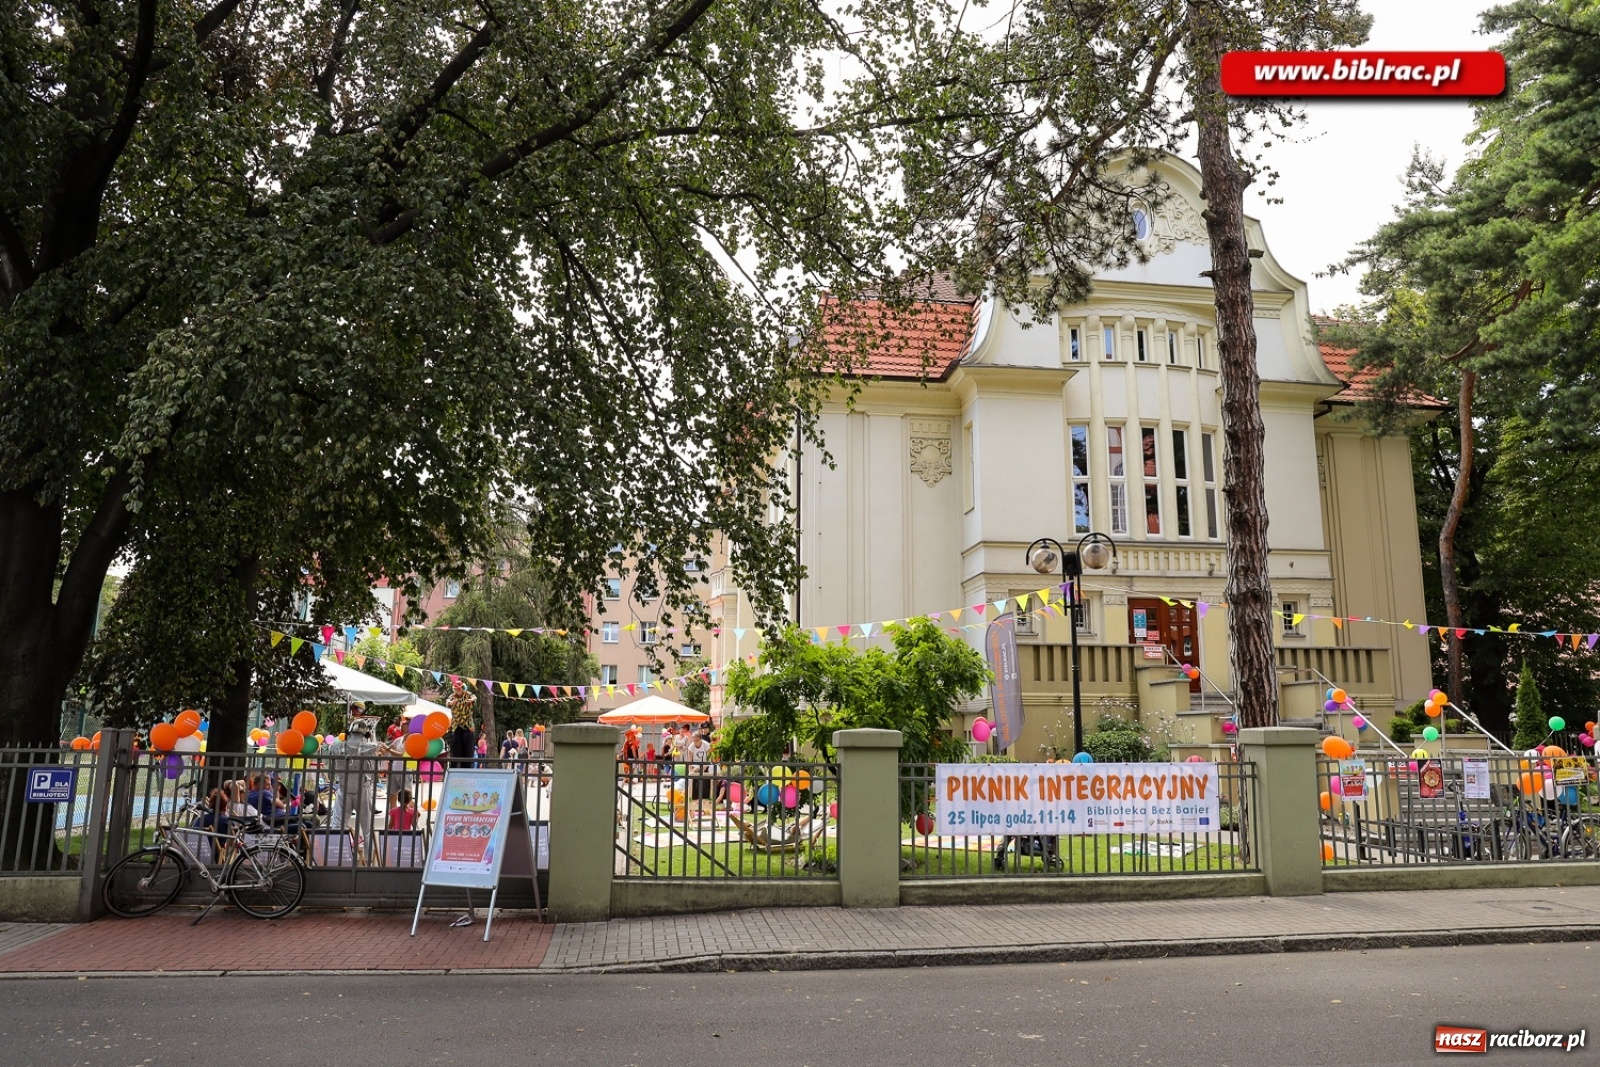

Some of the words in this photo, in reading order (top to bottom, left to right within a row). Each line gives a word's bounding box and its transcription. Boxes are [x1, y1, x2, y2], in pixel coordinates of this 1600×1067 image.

[36, 775, 49, 787] P
[946, 774, 1029, 803] PIKNIK
[1038, 773, 1209, 803] INTEGRACYJNY
[1087, 805, 1147, 816] Biblioteka
[1151, 805, 1171, 815] Bez
[1175, 804, 1210, 815] Barier
[947, 810, 966, 825] 25
[971, 809, 1001, 828] lipca
